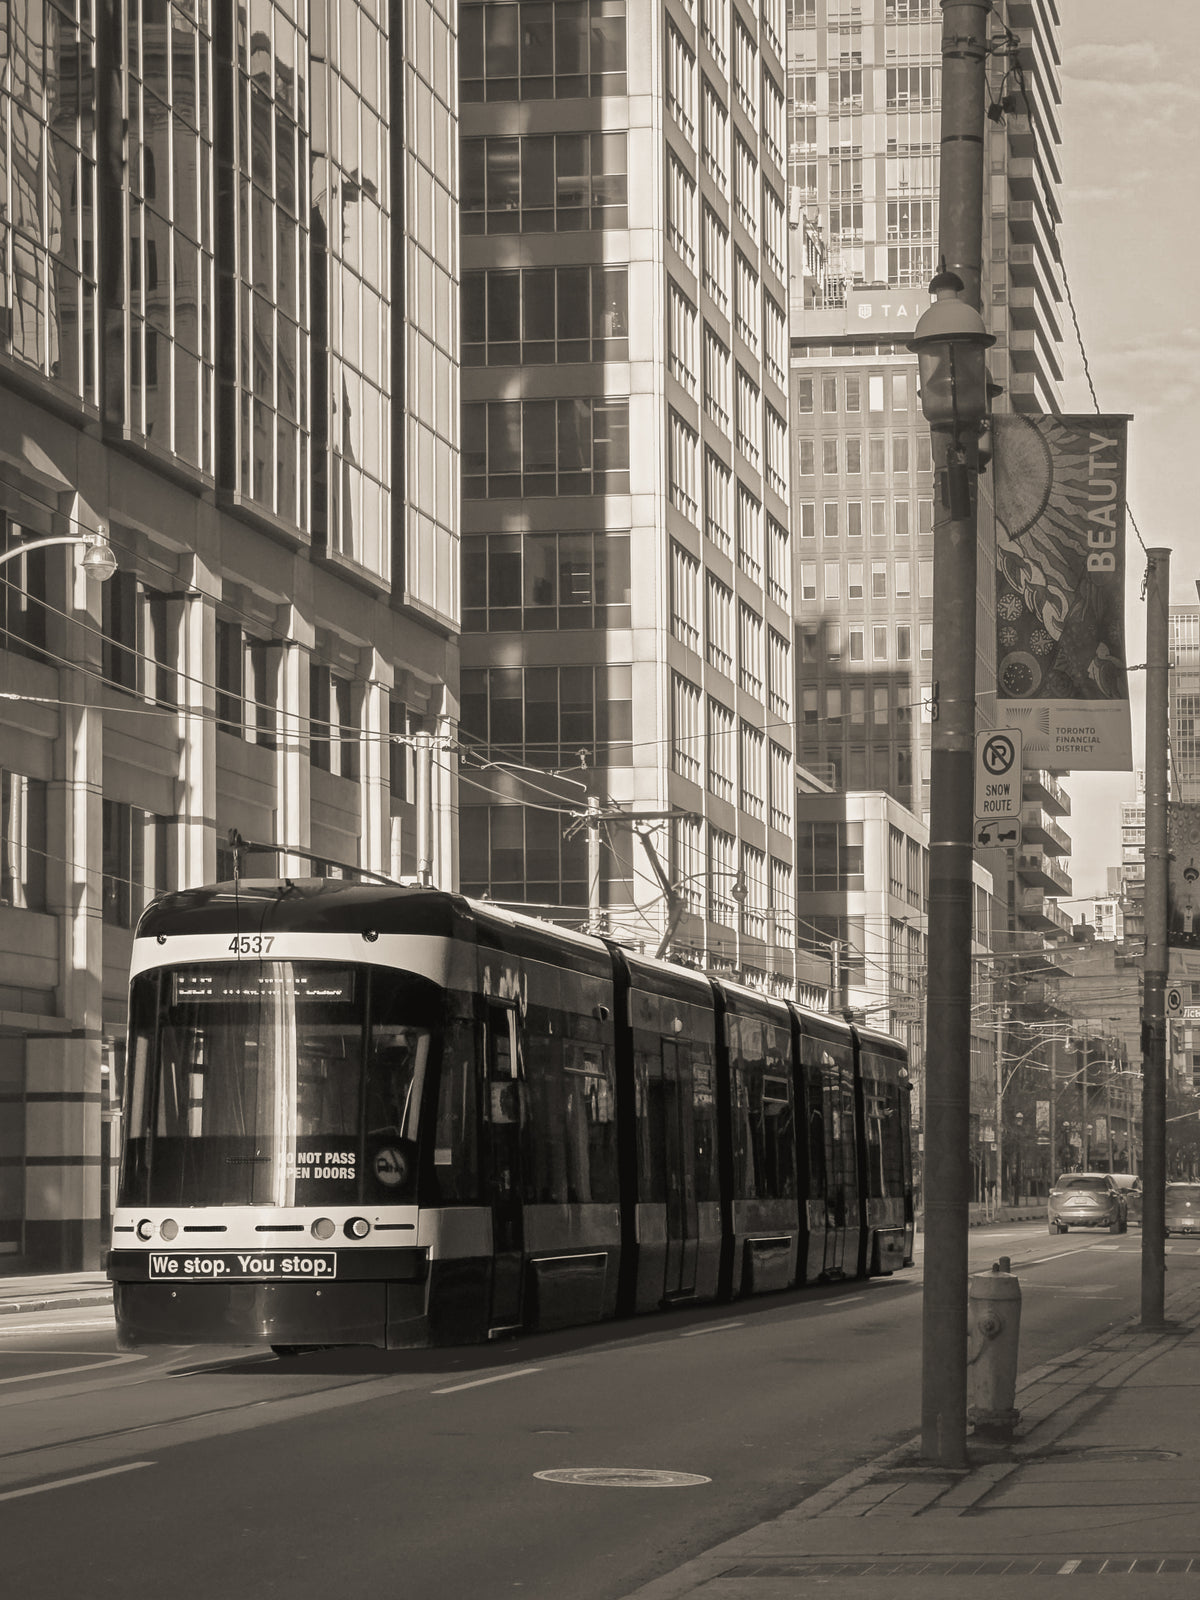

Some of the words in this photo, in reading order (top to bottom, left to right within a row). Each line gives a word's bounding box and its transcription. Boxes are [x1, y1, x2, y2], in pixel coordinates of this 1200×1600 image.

[1087, 432, 1118, 572] BEAUTY
[1055, 727, 1096, 735] TORONTO
[1055, 736, 1101, 744] FINANCIAL
[1055, 745, 1094, 753] DISTRICT
[985, 784, 1011, 797] SNOW
[983, 799, 1012, 812] ROUTE
[228, 936, 275, 954] 4537
[297, 1152, 322, 1164] NOT
[324, 1152, 356, 1165] PASS
[277, 1167, 311, 1180] PEN
[314, 1167, 356, 1180] DOORS
[152, 1256, 179, 1273] We
[183, 1257, 231, 1277] stop.
[237, 1256, 275, 1273] You
[281, 1256, 332, 1277] stop.
